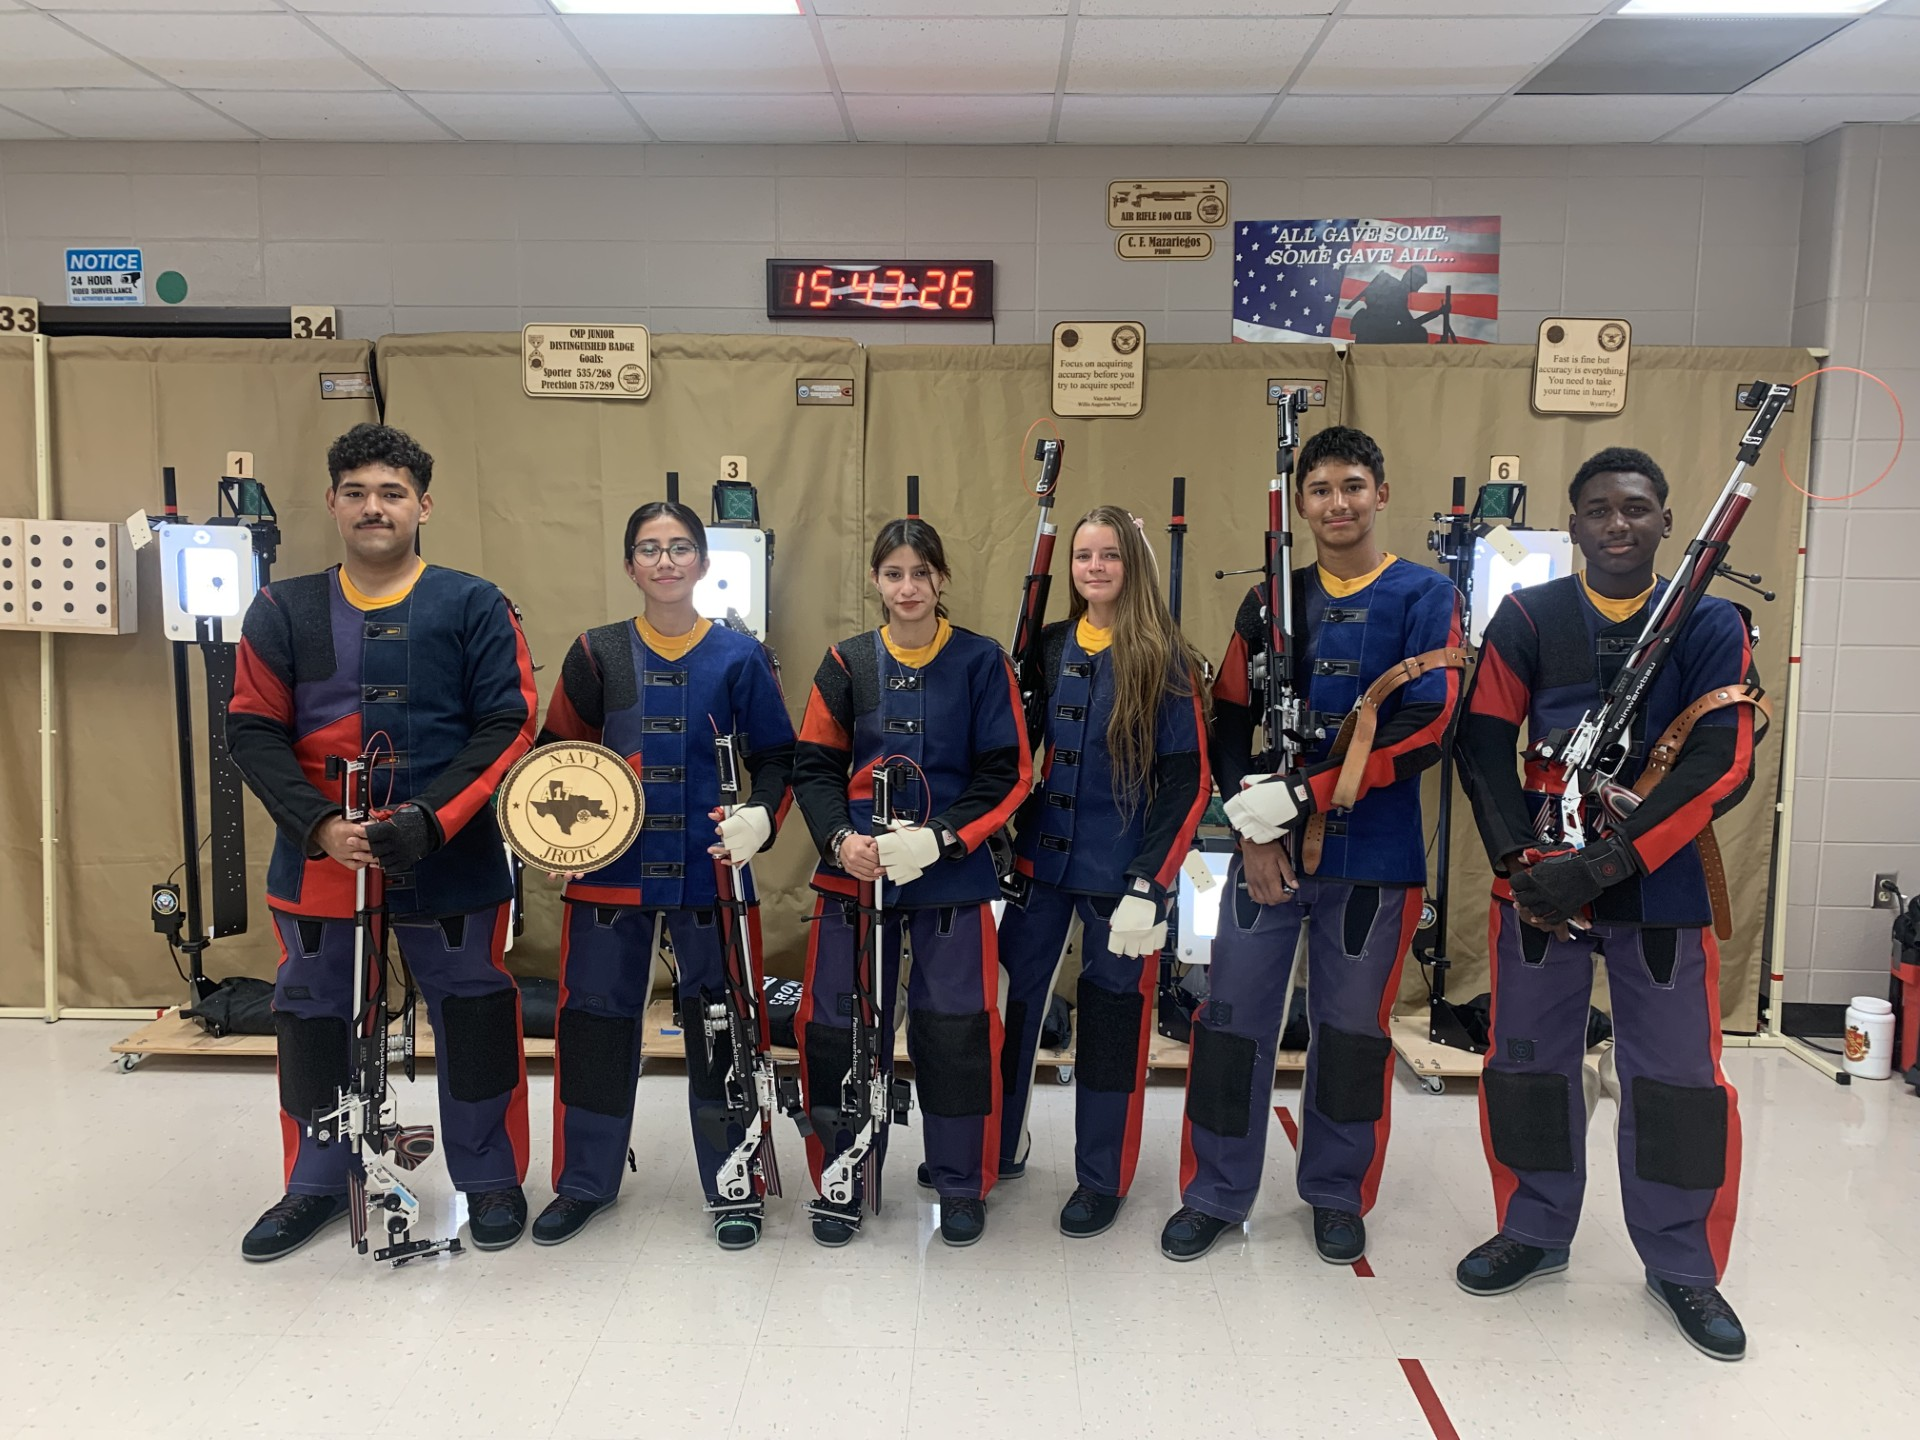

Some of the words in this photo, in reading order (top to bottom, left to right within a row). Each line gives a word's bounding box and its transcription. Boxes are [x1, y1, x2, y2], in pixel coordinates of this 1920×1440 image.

[1121, 212, 1134, 221] AIR
[1136, 212, 1156, 221] RIFLE
[1159, 212, 1172, 221] 100
[1174, 211, 1192, 220] CLUB
[1128, 236, 1136, 247] C.
[1139, 237, 1146, 247] F.
[1149, 236, 1201, 248] Mazariegos
[1275, 228, 1316, 244] ALL
[1322, 226, 1382, 243] GAVE
[1383, 225, 1450, 244] SOME,
[70, 254, 139, 269] NOTICE
[1269, 249, 1336, 265] SOME
[1336, 248, 1393, 265] GAVE
[1396, 247, 1455, 263] ALL...
[71, 276, 83, 286] 24
[87, 275, 113, 285] HOUR
[795, 269, 974, 309] 15:43:26
[0, 306, 36, 332] 33
[294, 316, 335, 339] 34
[569, 329, 585, 338] CMP
[587, 329, 614, 339] JUNIOR
[549, 341, 607, 351] DISTINGUISHED
[608, 342, 635, 351] BADGE
[579, 354, 604, 363] Goals:
[1096, 360, 1133, 369] acquiring
[1553, 355, 1570, 363] Fast
[1572, 355, 1579, 363] is
[1580, 355, 1596, 363] fine
[543, 368, 572, 378] Sporter
[576, 368, 612, 378] 535/268
[1058, 371, 1091, 380] accuracy
[1093, 370, 1118, 378] before
[1119, 372, 1135, 380] you
[1538, 367, 1572, 375] accuracy
[541, 380, 577, 389] Precision
[579, 381, 615, 390] 578/289
[1058, 382, 1068, 390] try
[1080, 382, 1108, 390] acquire
[1110, 381, 1135, 390] speed!
[1548, 376, 1564, 384] You
[1596, 377, 1612, 385] take
[1543, 388, 1561, 396] your
[1592, 388, 1616, 398] hurry!
[235, 457, 243, 474] 1
[727, 461, 739, 479] 3
[1498, 462, 1510, 480] 6
[203, 616, 214, 642] 1
[1613, 662, 1656, 730] Feinwerkbau
[549, 751, 608, 769] NAVY
[540, 786, 573, 801] A17
[539, 845, 600, 864] JROTC
[405, 1037, 413, 1056] 800
[728, 1011, 740, 1073] Feinwerkbau
[378, 1025, 386, 1093] Feinwerkbau
